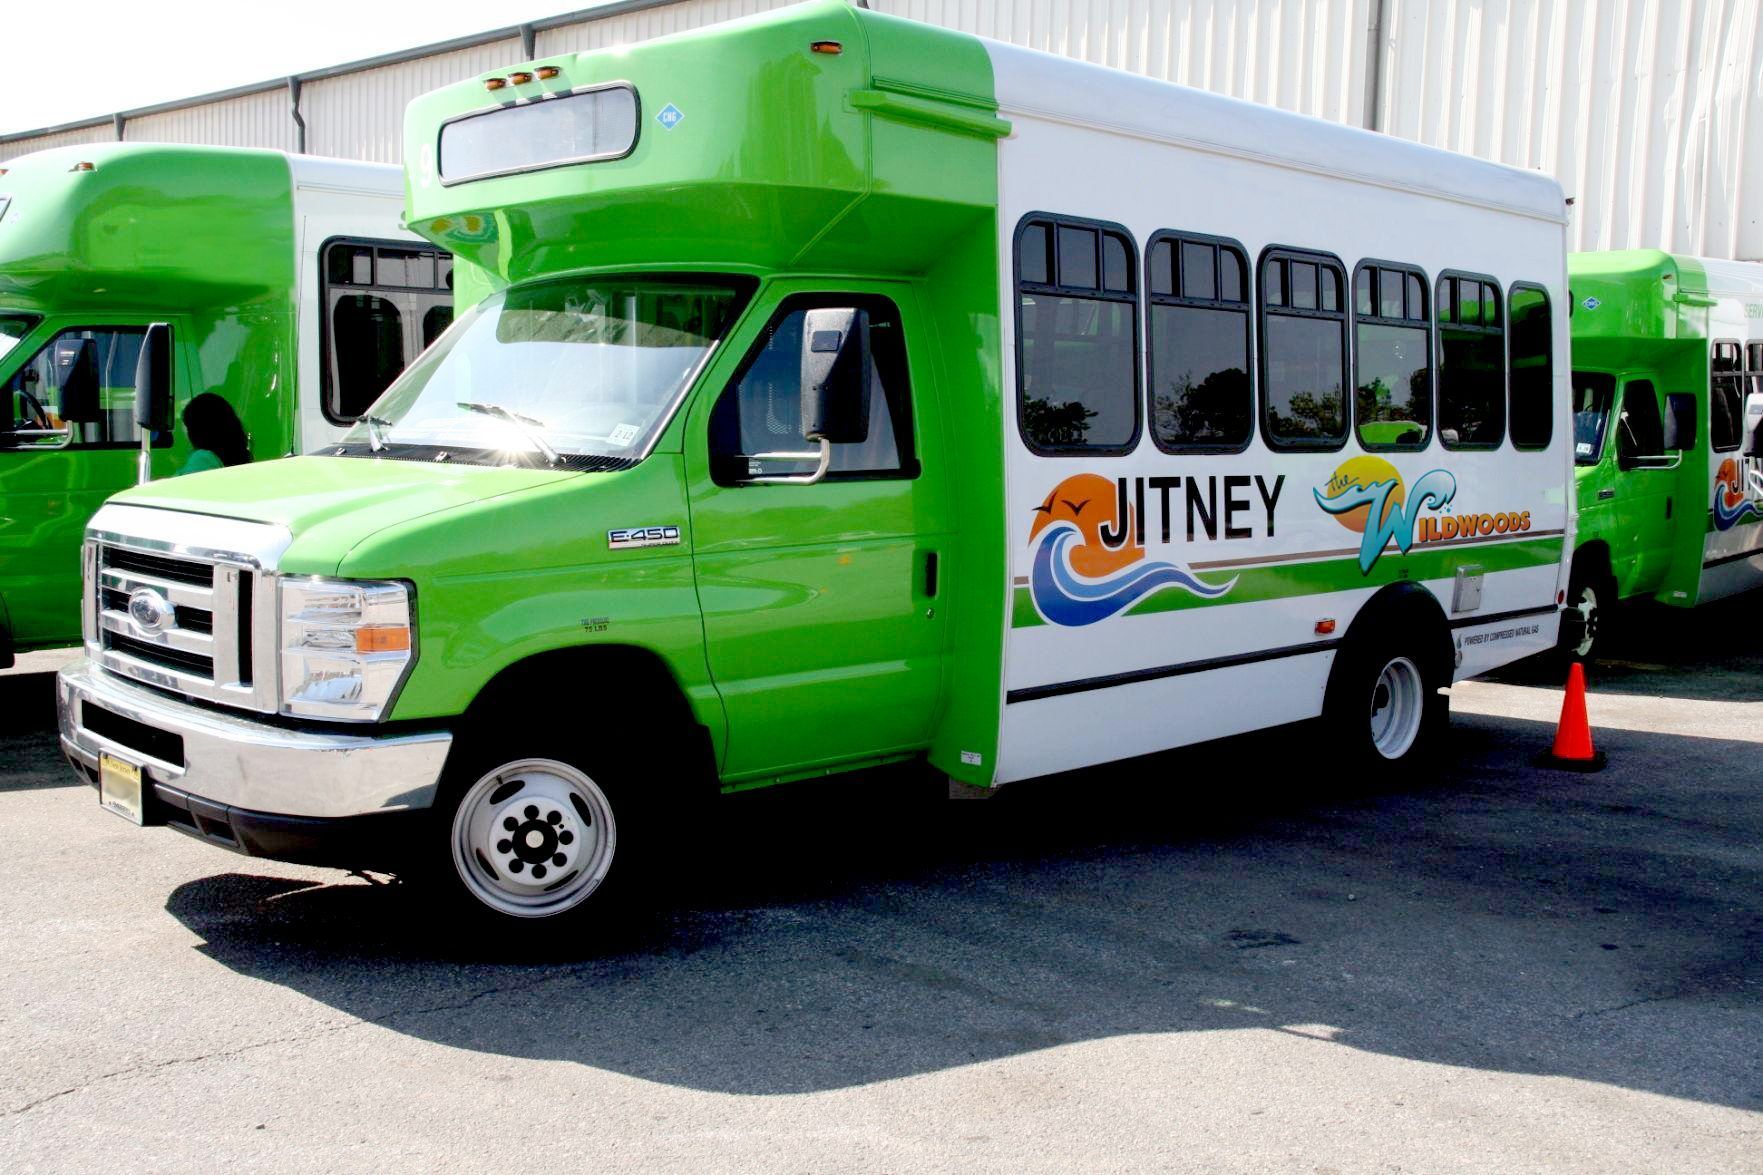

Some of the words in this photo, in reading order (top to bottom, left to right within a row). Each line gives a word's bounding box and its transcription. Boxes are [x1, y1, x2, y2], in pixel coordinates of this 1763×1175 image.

[662, 111, 677, 123] CNG
[1324, 470, 1359, 491] the
[1100, 474, 1286, 548] JITNEY
[1464, 634, 1484, 646] POWERED
[1490, 628, 1515, 642] COMPRESSED
[1515, 626, 1531, 637] NATURAL
[1531, 624, 1540, 634] GAS
